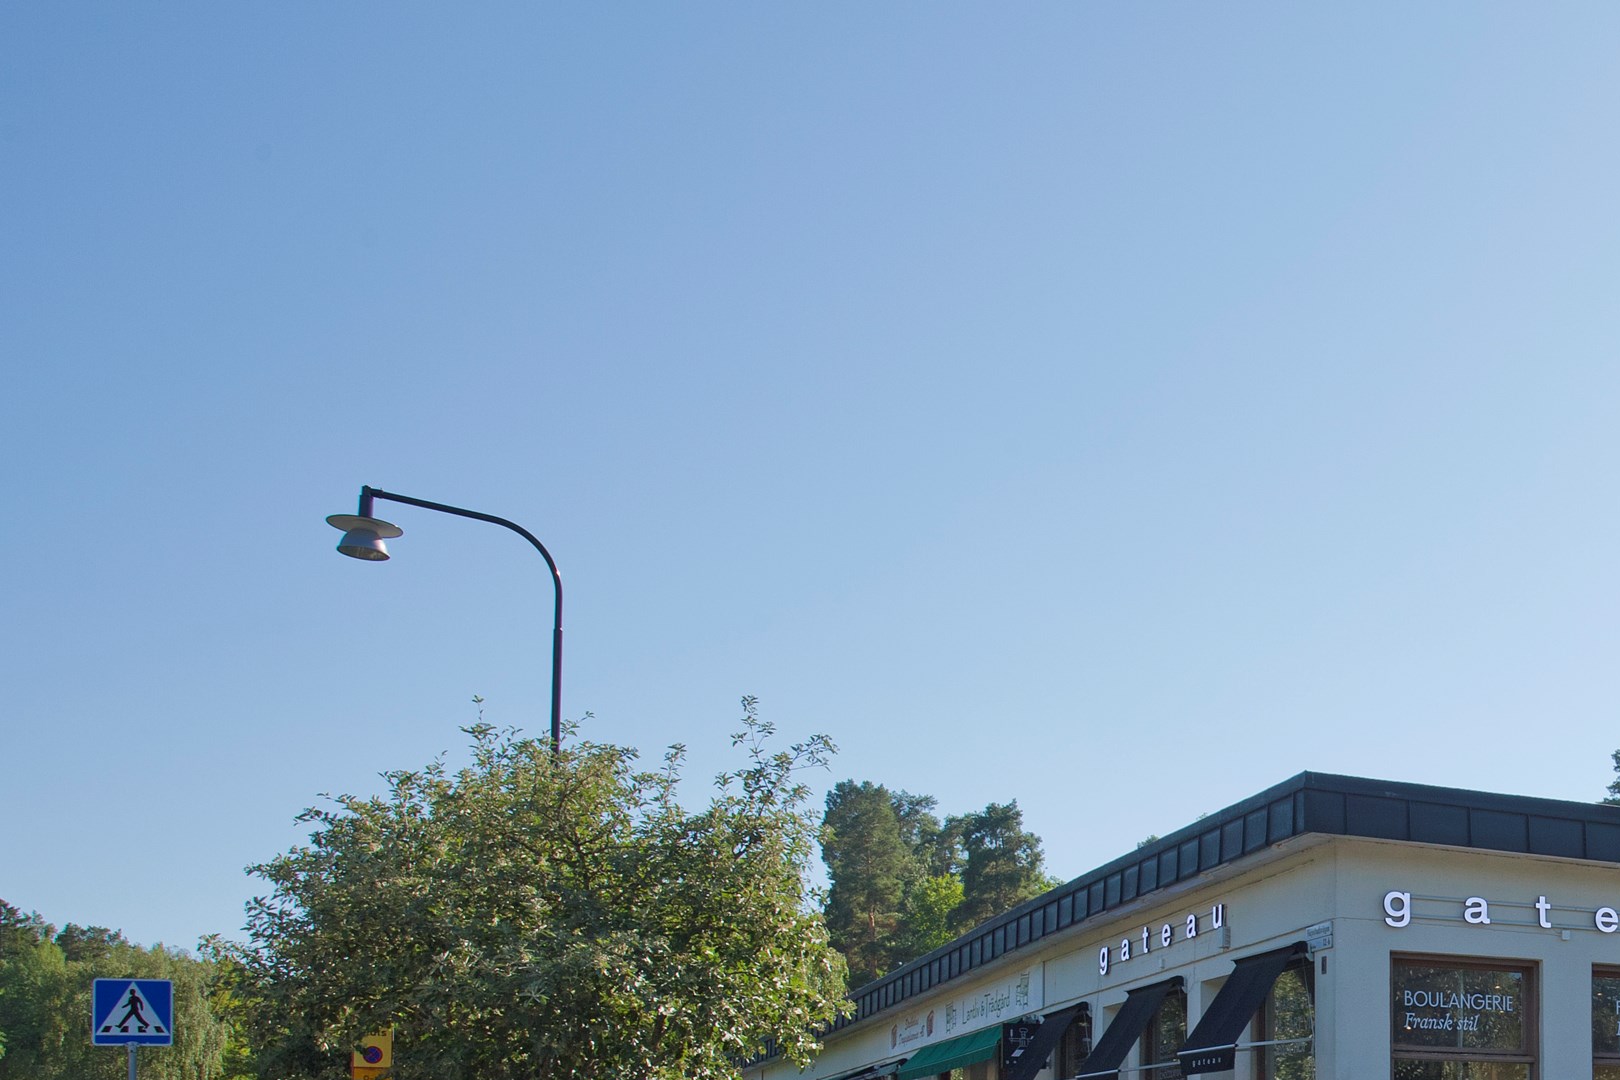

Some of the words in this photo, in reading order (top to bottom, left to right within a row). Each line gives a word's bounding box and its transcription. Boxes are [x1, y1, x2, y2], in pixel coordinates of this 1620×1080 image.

[1099, 903, 1223, 976] gateau
[1404, 990, 1513, 1012] BOULANGERIE
[1404, 1012, 1453, 1031] Fransk
[1457, 1014, 1480, 1031] stil
[1192, 1056, 1222, 1068] gateau
